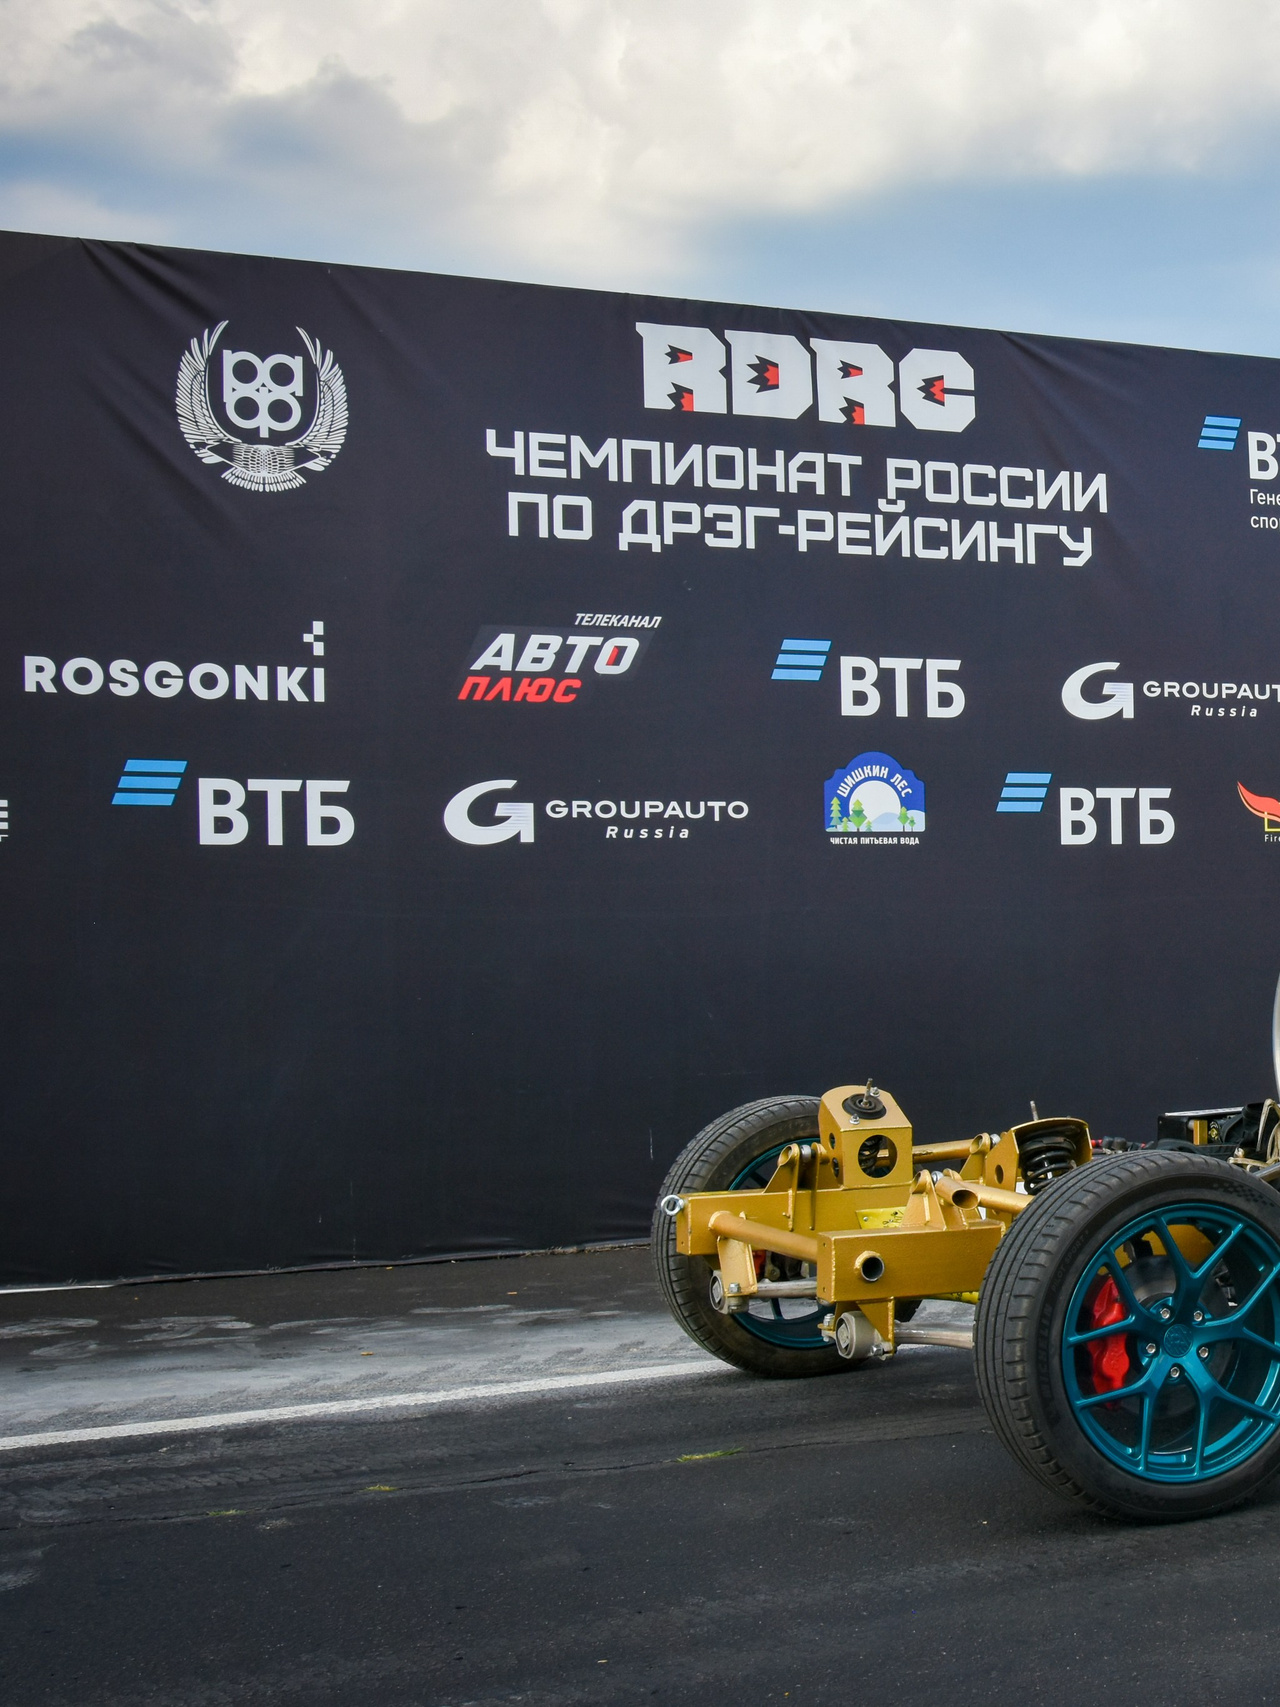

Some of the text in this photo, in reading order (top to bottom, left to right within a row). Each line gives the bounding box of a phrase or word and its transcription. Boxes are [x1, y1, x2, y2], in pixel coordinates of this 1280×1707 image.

[635, 321, 976, 433] RDRC
[486, 428, 1108, 513] ЧЕМПИОНАТ РОССИИ
[508, 492, 1094, 567] ПО ДРЭГ-РЕЙСИНГУ
[575, 612, 663, 629] ТЕЛЕКАНАЛ
[470, 633, 640, 675] АВТО
[25, 655, 326, 702] ROSGONKI
[458, 676, 582, 704] ПЛЮС
[840, 656, 966, 718] ВТБ
[1190, 704, 1258, 718] Russia
[836, 765, 912, 798] ШИШКИН ЛЕС
[198, 778, 356, 847] ВТБ
[546, 799, 749, 822] GROUPAUTO
[1060, 788, 1176, 845] ВТБ
[605, 825, 690, 839] Russia
[829, 836, 920, 846] ЧИСТАЯ ПИТЬЕВАЯ ВОДА
